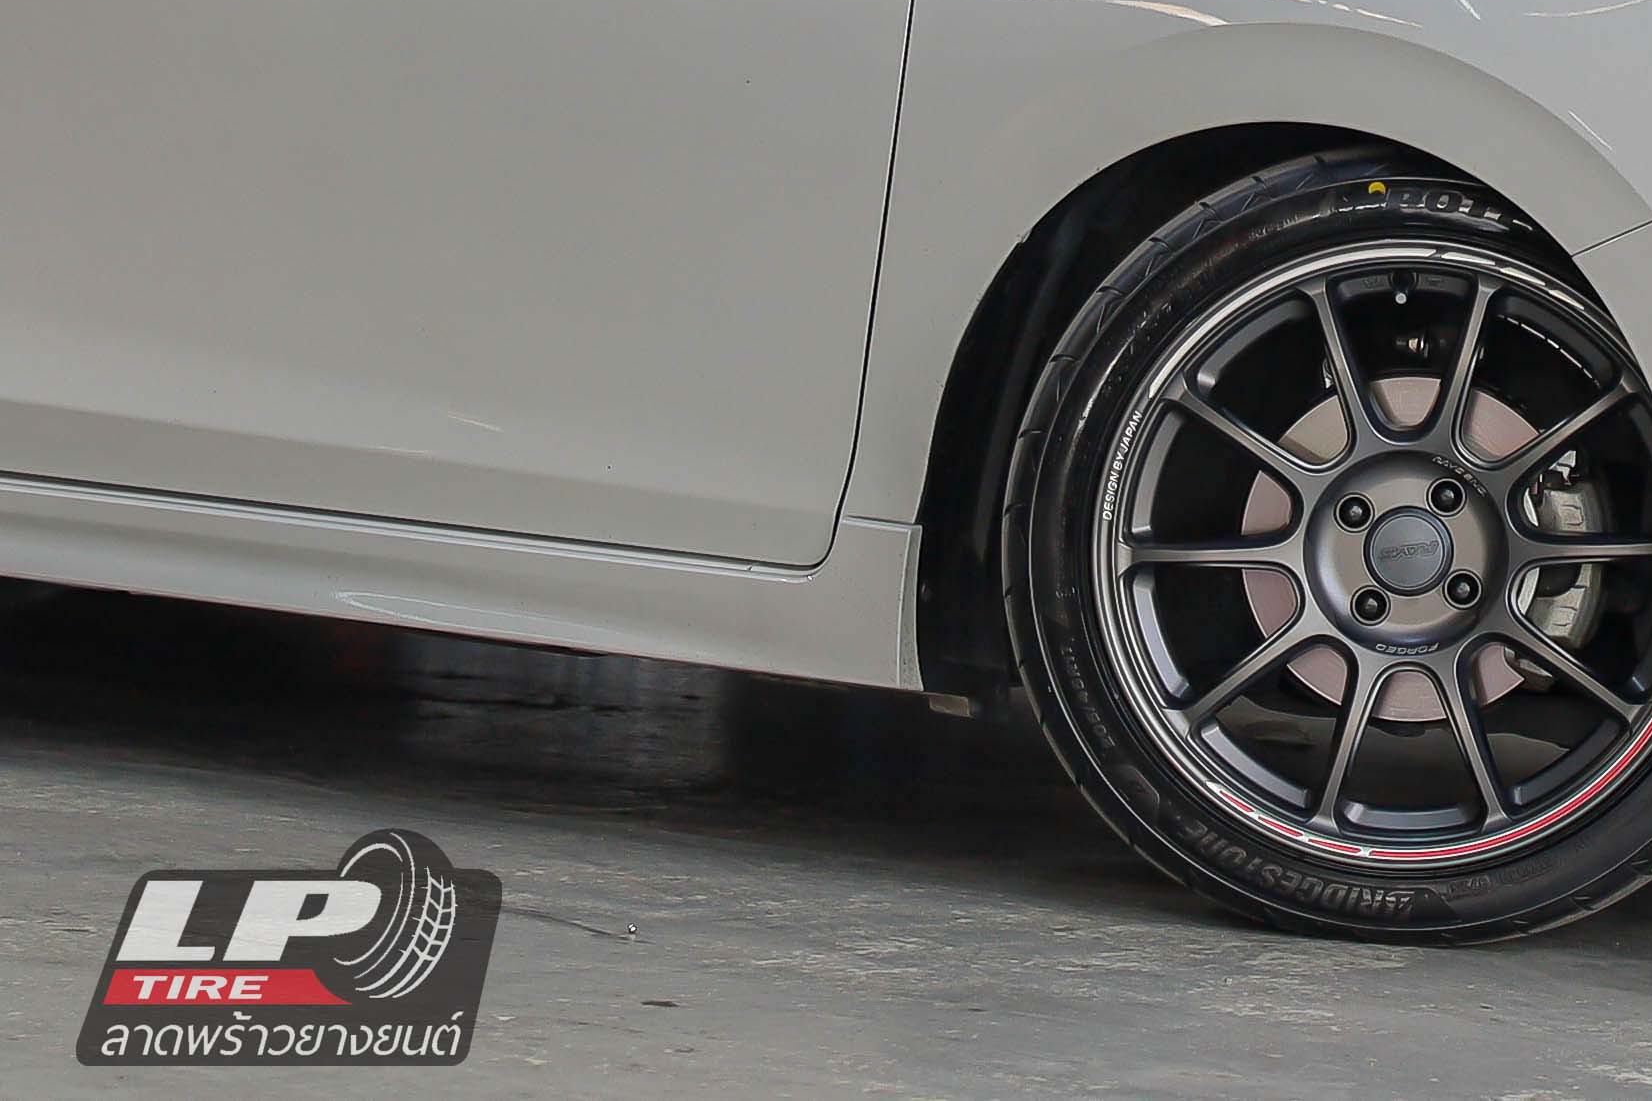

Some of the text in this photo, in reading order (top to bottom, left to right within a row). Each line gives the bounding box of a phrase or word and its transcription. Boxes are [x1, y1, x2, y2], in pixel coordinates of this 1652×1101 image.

[1102, 410, 1144, 522] DESIGN BY JAPAN
[1375, 642, 1440, 656] FORGED
[1183, 818, 1415, 919] BRIDGESTONE
